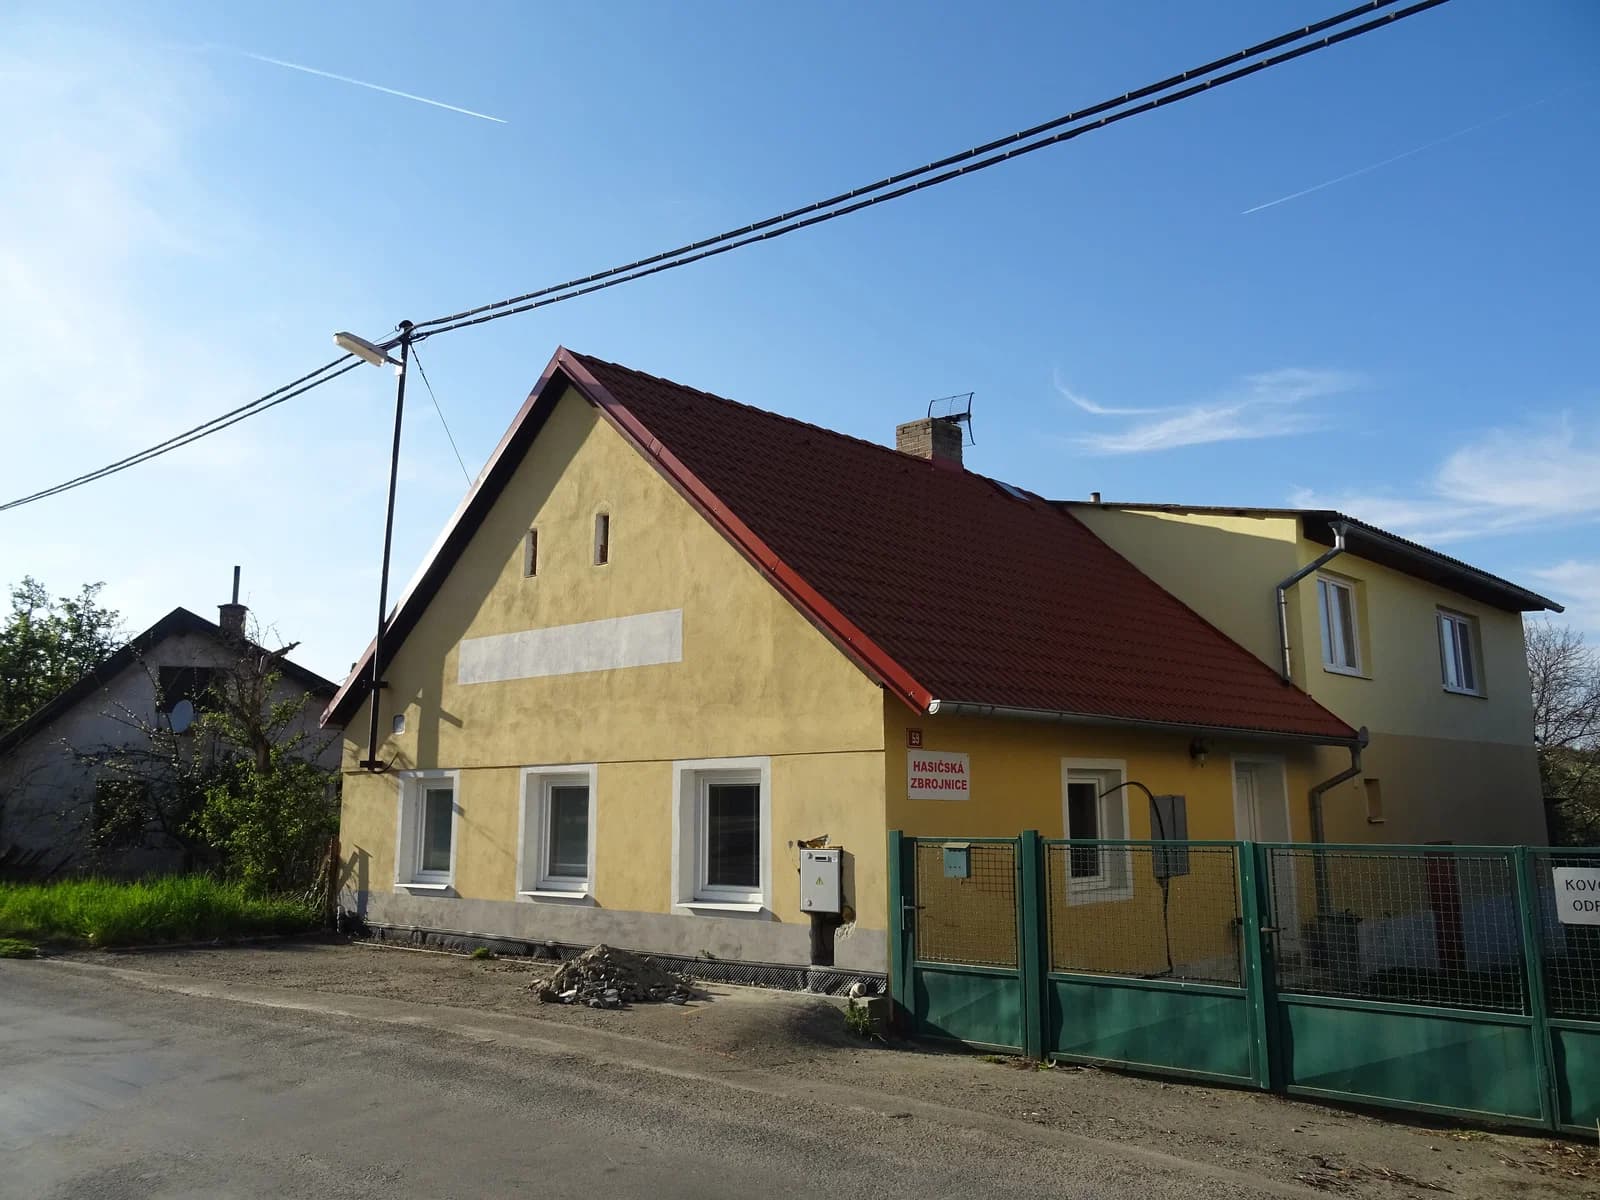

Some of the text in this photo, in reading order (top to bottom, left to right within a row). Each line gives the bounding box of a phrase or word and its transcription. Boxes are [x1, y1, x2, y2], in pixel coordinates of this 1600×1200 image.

[913, 760, 965, 774] HASIČSKÁ
[910, 777, 968, 791] ZBROJNICE
[1565, 879, 1600, 892] KOV
